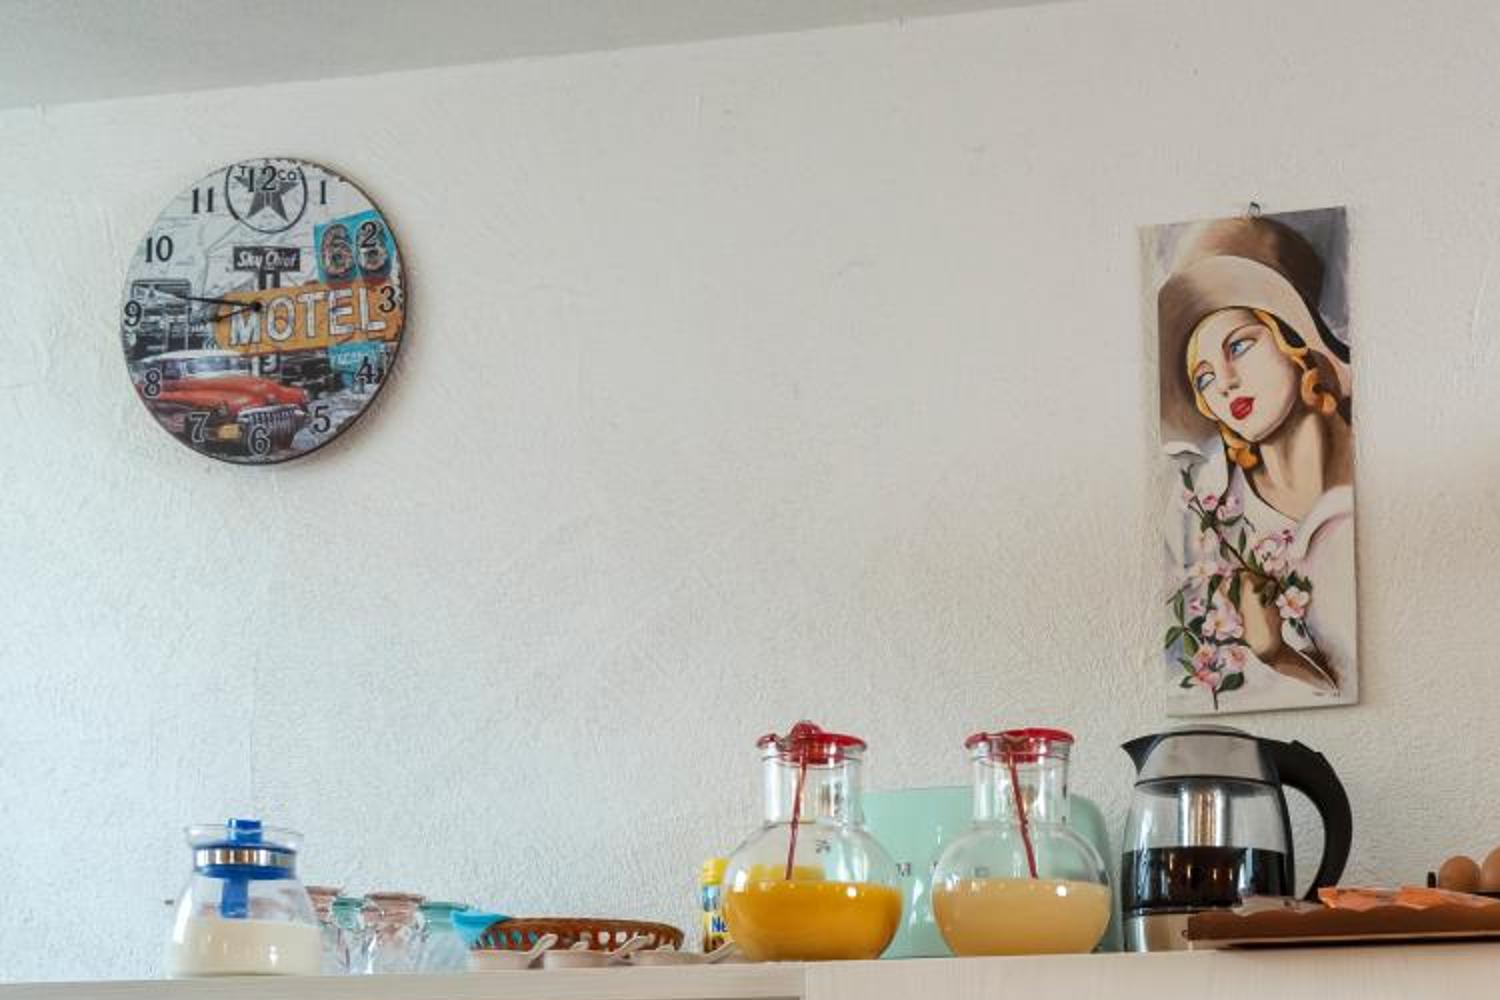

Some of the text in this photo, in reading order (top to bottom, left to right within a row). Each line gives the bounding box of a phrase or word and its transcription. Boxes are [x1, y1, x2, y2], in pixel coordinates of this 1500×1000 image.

[247, 166, 276, 192] 12
[319, 180, 327, 204] 1
[192, 187, 214, 214] 11
[361, 222, 377, 248] 2
[145, 236, 173, 262] 10
[124, 300, 142, 327] 9
[379, 287, 396, 313] 3
[230, 288, 385, 346] MOTEL
[355, 356, 376, 382] 4
[143, 369, 161, 397] 8
[190, 413, 210, 443] 7
[313, 406, 331, 433] 5
[249, 426, 270, 455] 6
